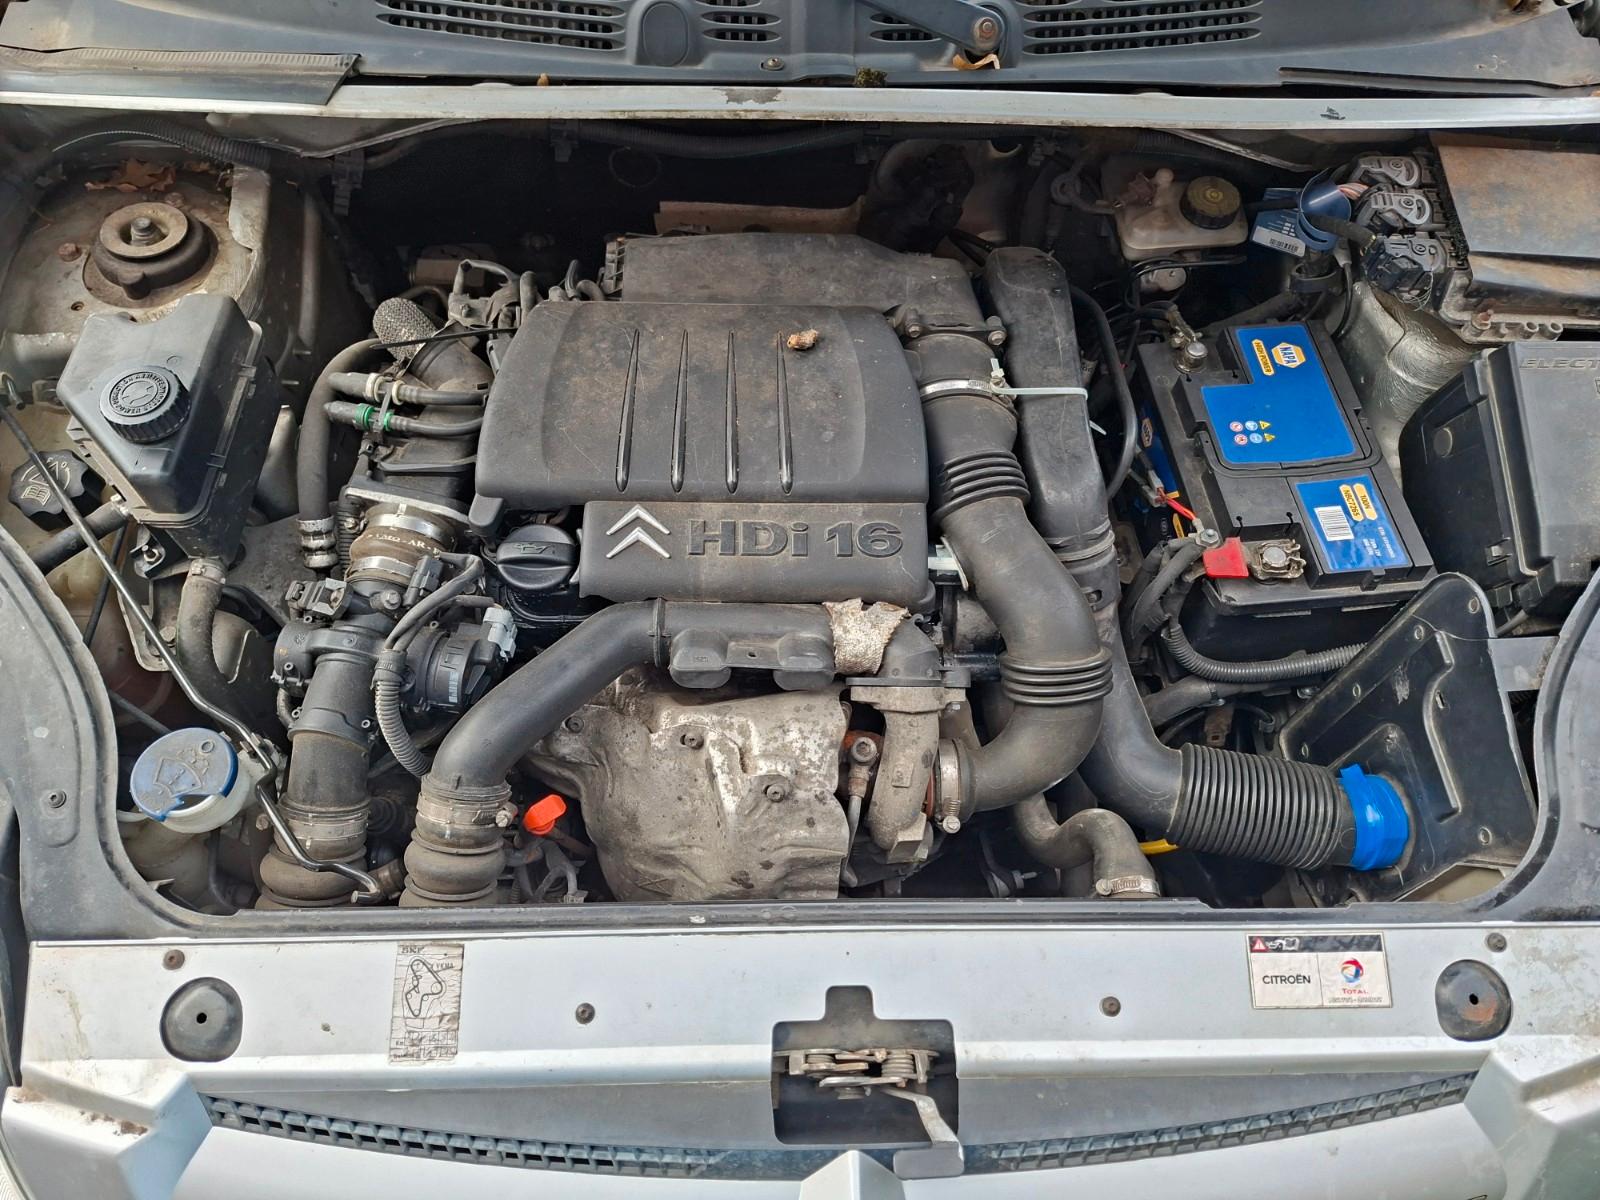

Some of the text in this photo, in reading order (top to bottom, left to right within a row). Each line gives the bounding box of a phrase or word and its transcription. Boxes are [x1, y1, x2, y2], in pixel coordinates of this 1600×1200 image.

[1280, 346, 1297, 364] NAPA
[687, 519, 903, 558] HDi 16
[1262, 974, 1311, 985] CITROËN
